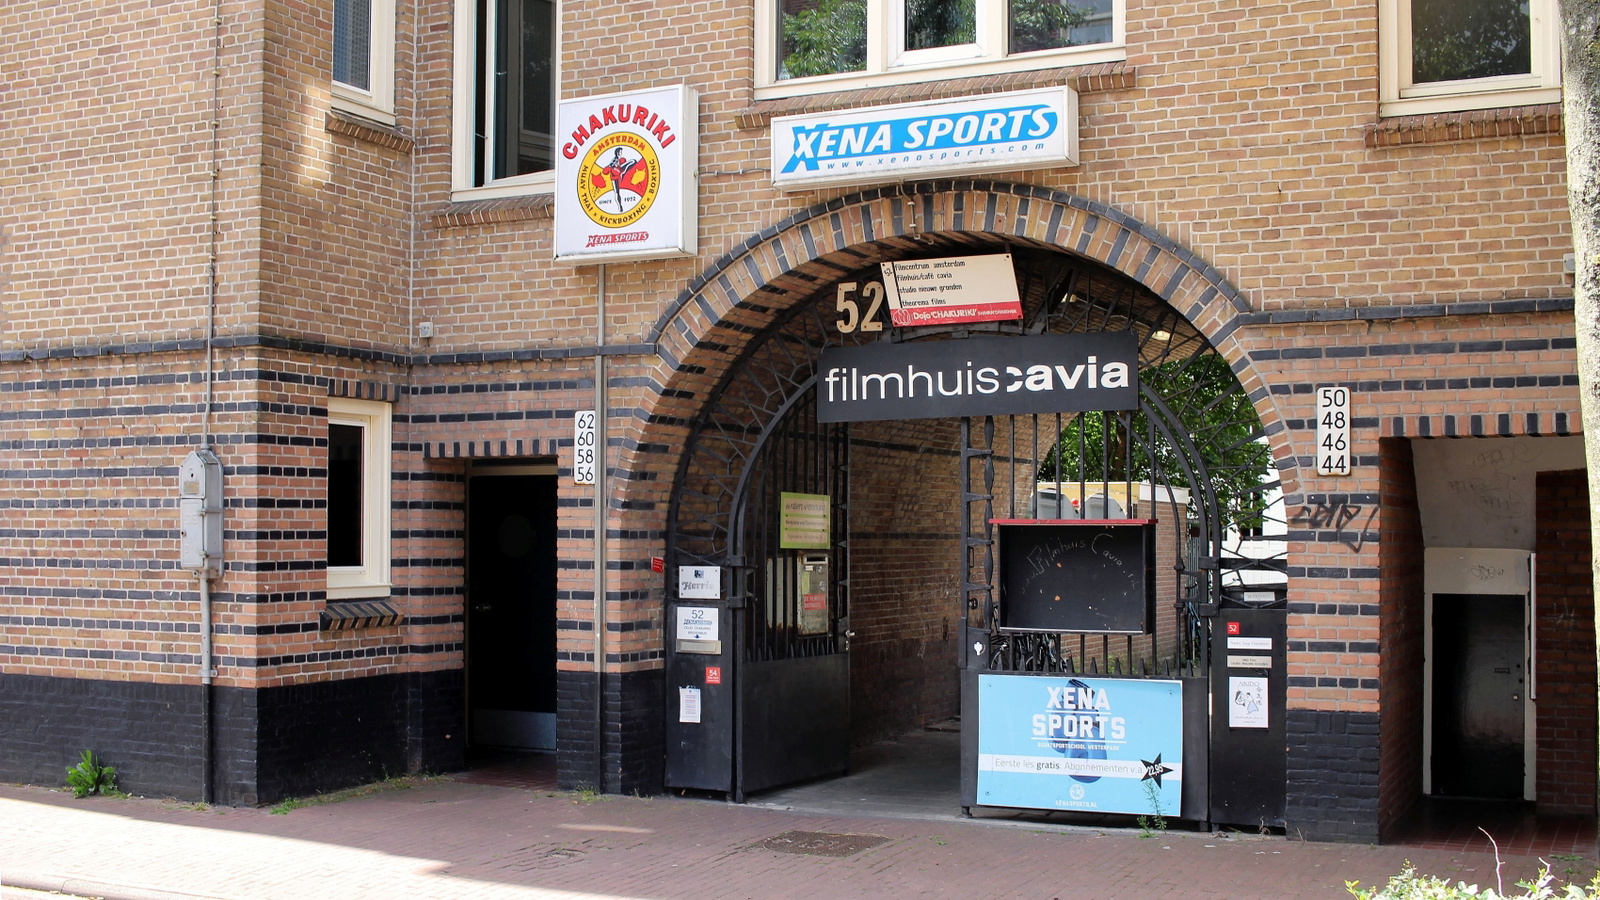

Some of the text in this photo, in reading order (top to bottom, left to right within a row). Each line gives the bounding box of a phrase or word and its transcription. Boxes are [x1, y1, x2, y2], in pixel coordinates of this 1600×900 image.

[562, 104, 676, 160] CHAKURIKI
[782, 107, 1051, 172] XENA SPORTS
[593, 135, 646, 156] AMSTERDAM
[649, 158, 657, 194] BOXING
[580, 165, 593, 211] MUAY THAI
[600, 203, 646, 224] KICKBOXING
[586, 234, 612, 247] XENA
[614, 231, 648, 242] SPORTS
[934, 260, 966, 268] amsterdam
[836, 281, 884, 333] 52
[913, 312, 930, 320] Dojo
[1322, 389, 1345, 407] 50
[578, 414, 594, 429] 62
[1321, 411, 1345, 429] 48
[577, 431, 594, 446] 60
[1322, 433, 1346, 451] 46
[577, 449, 594, 464] 58
[1322, 455, 1346, 473] 44
[577, 467, 594, 482] 56
[691, 609, 704, 619] 52
[709, 669, 717, 677] 54
[1046, 686, 1111, 711] XENA
[1032, 714, 1126, 739] SPORTS
[995, 758, 1021, 768] Eerste
[1023, 759, 1034, 768] les
[1064, 762, 1129, 773] Abonnementen
